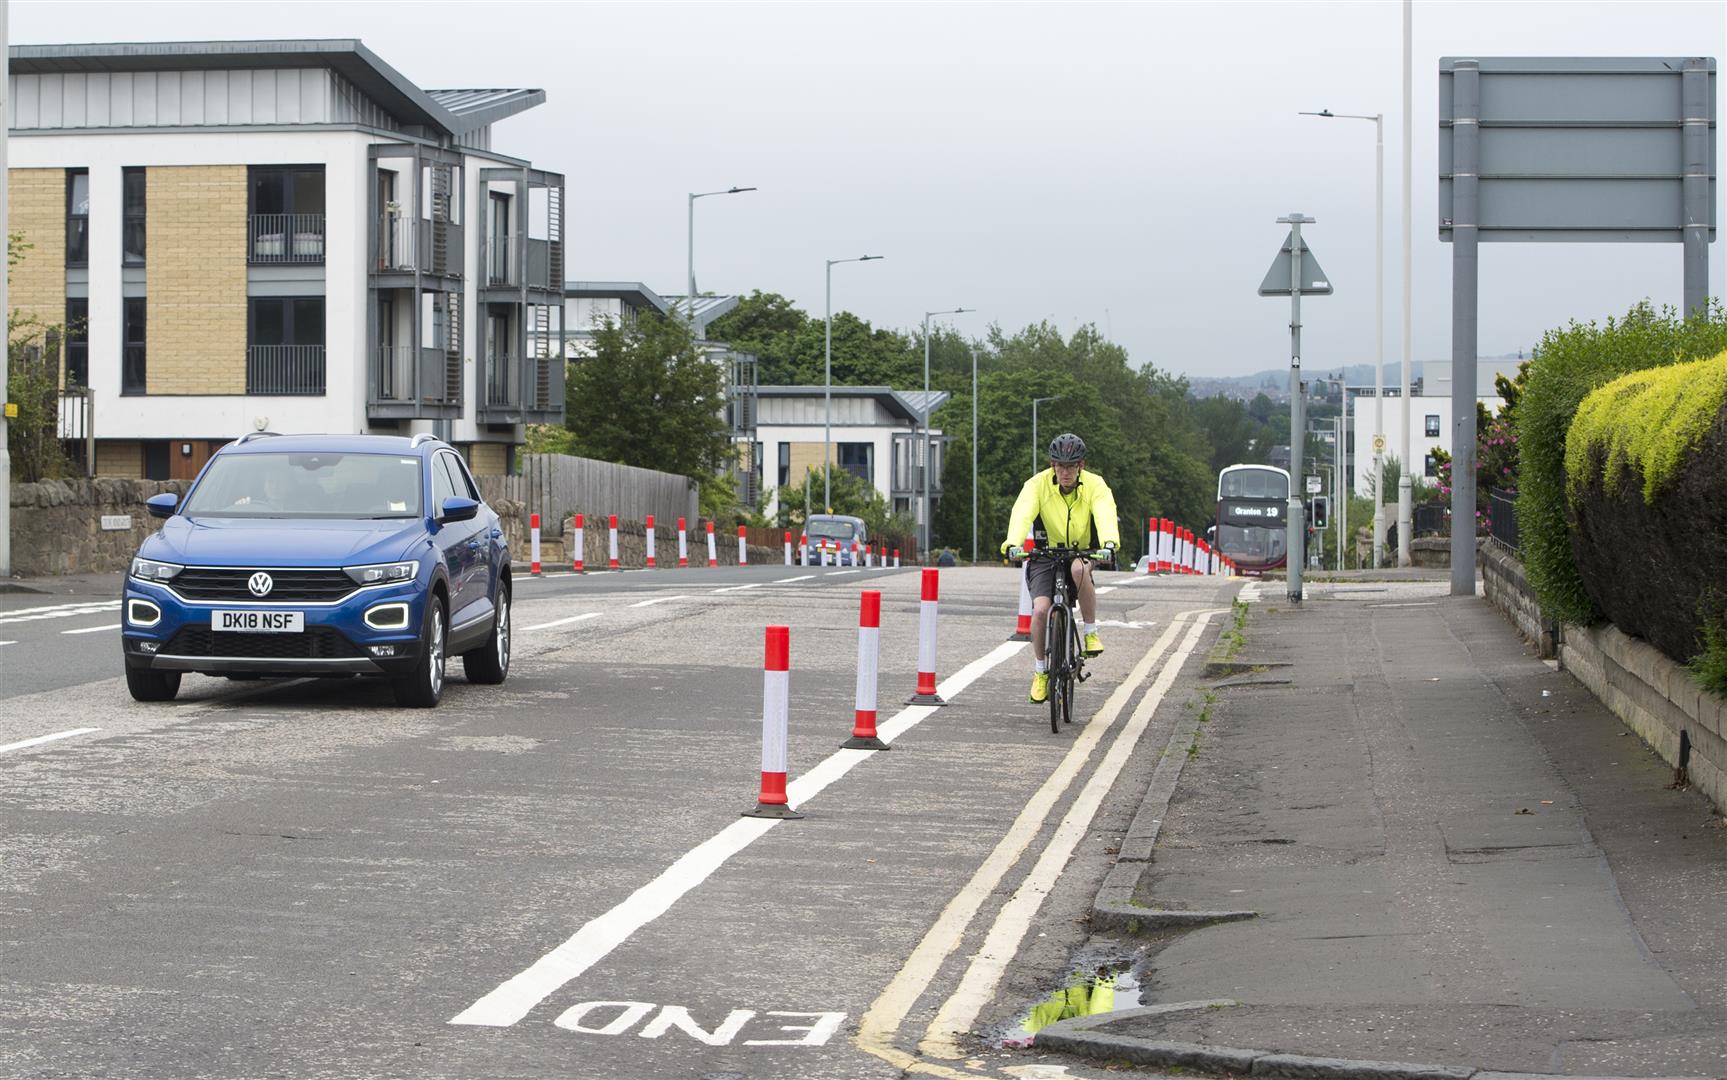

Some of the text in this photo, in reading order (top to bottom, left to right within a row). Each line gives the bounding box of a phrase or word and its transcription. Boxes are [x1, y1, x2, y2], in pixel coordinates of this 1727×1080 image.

[1235, 507, 1278, 517] Granton 19
[223, 613, 294, 629] DK18 NSF
[553, 1001, 848, 1046] END
